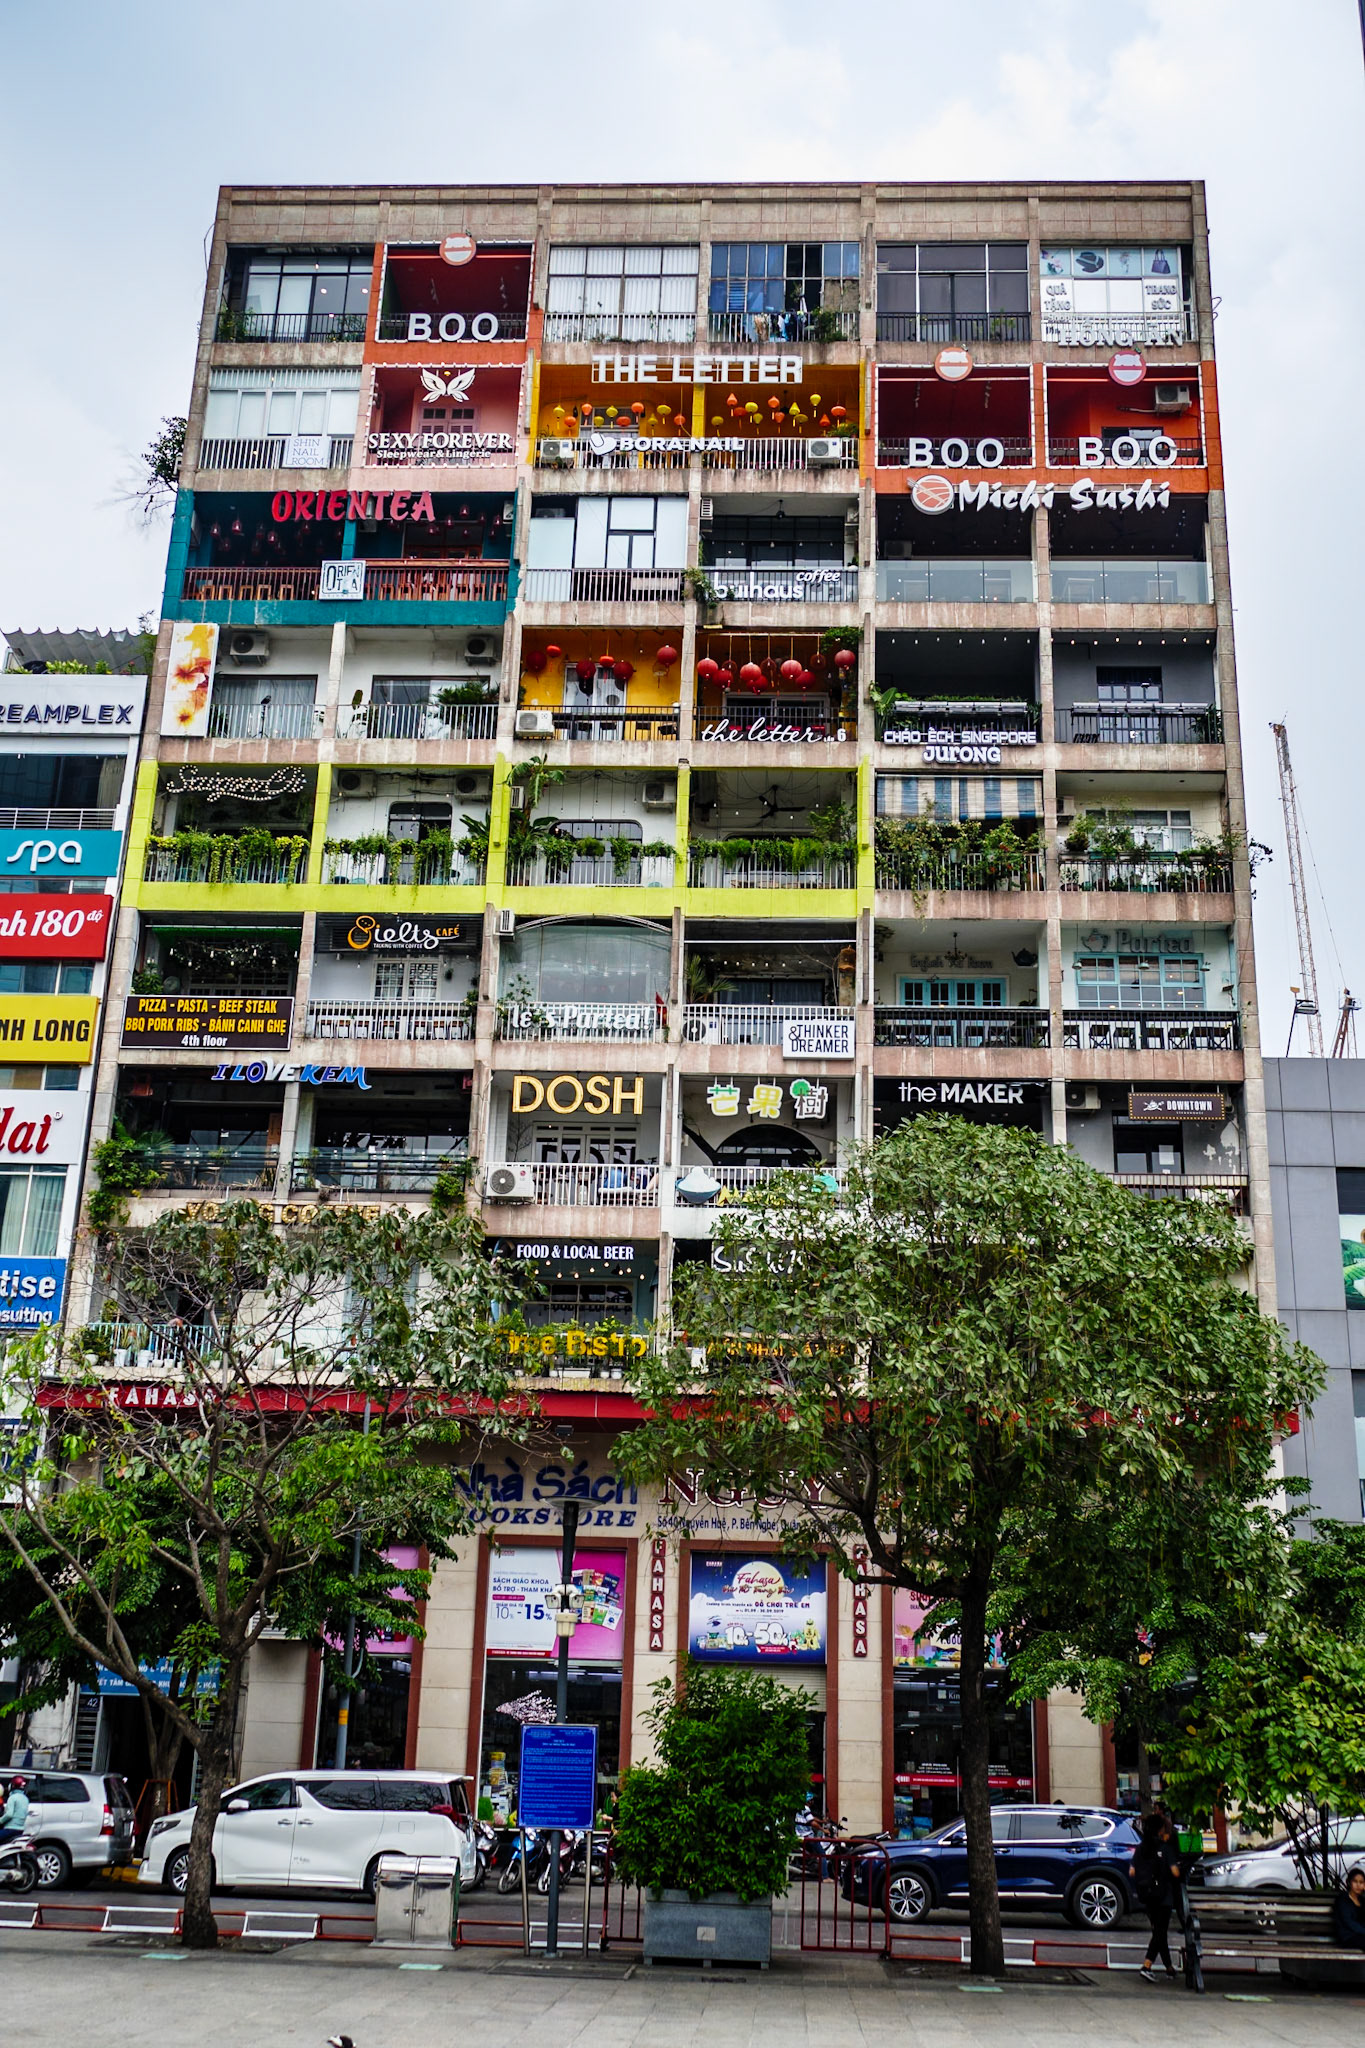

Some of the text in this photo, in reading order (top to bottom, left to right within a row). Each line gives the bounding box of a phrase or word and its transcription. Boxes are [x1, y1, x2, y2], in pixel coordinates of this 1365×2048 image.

[1045, 283, 1067, 296] QUÀ
[1145, 284, 1178, 295] TRANG
[407, 313, 499, 341] BOO
[592, 355, 803, 383] THE LETTER
[293, 438, 320, 447] SHIN
[368, 433, 513, 449] SEXY FOREVER
[620, 437, 745, 451] BORA NAIL
[292, 448, 319, 457] NAIL
[908, 437, 1005, 468] BOO
[1078, 436, 1178, 467] BOO
[291, 457, 325, 466] ROOM
[958, 477, 1170, 512] Michi Sushi
[271, 489, 436, 522] ORIENTEA
[796, 570, 841, 583] coffee
[337, 579, 358, 591] TA
[701, 718, 744, 742] the
[747, 717, 823, 743] letter
[837, 728, 847, 742] 6
[883, 727, 921, 743] CHÁO
[961, 730, 1037, 744] SINGAPORE
[6, 839, 83, 872] spa
[30, 909, 84, 937] 180
[86, 909, 104, 923] độ
[435, 924, 460, 936] CAFÉ
[1115, 929, 1195, 953] Partea
[138, 999, 167, 1013] PIZZA
[177, 1000, 208, 1013] PASTA
[218, 1000, 243, 1013] BEEF
[246, 1001, 278, 1014] STEAK
[33, 1019, 91, 1042] LONG
[125, 1019, 146, 1031] BBQ
[147, 1019, 174, 1032] PORK
[176, 1019, 199, 1032] RIBS
[208, 1017, 235, 1032] BÁNH
[237, 1020, 264, 1033] CANH
[265, 1019, 286, 1036] GHẸ
[797, 1024, 849, 1039] THINKER
[181, 1035, 228, 1048] 4th floor
[791, 1040, 849, 1053] DREAMER
[211, 1057, 372, 1090] I LOVE KEM
[512, 1075, 644, 1115] DOSH
[899, 1082, 1024, 1104] the MAKER
[1166, 1100, 1213, 1111] DOWNTOWN
[186, 1202, 275, 1223] YOG
[516, 1244, 634, 1260] FOOD & LOCAL BEER
[463, 1507, 638, 1527] OOKSORE
[731, 1517, 739, 1528] P.
[492, 1576, 511, 1584] SÁCH
[512, 1577, 529, 1585] GIÁO
[736, 1571, 781, 1587] Fahasa
